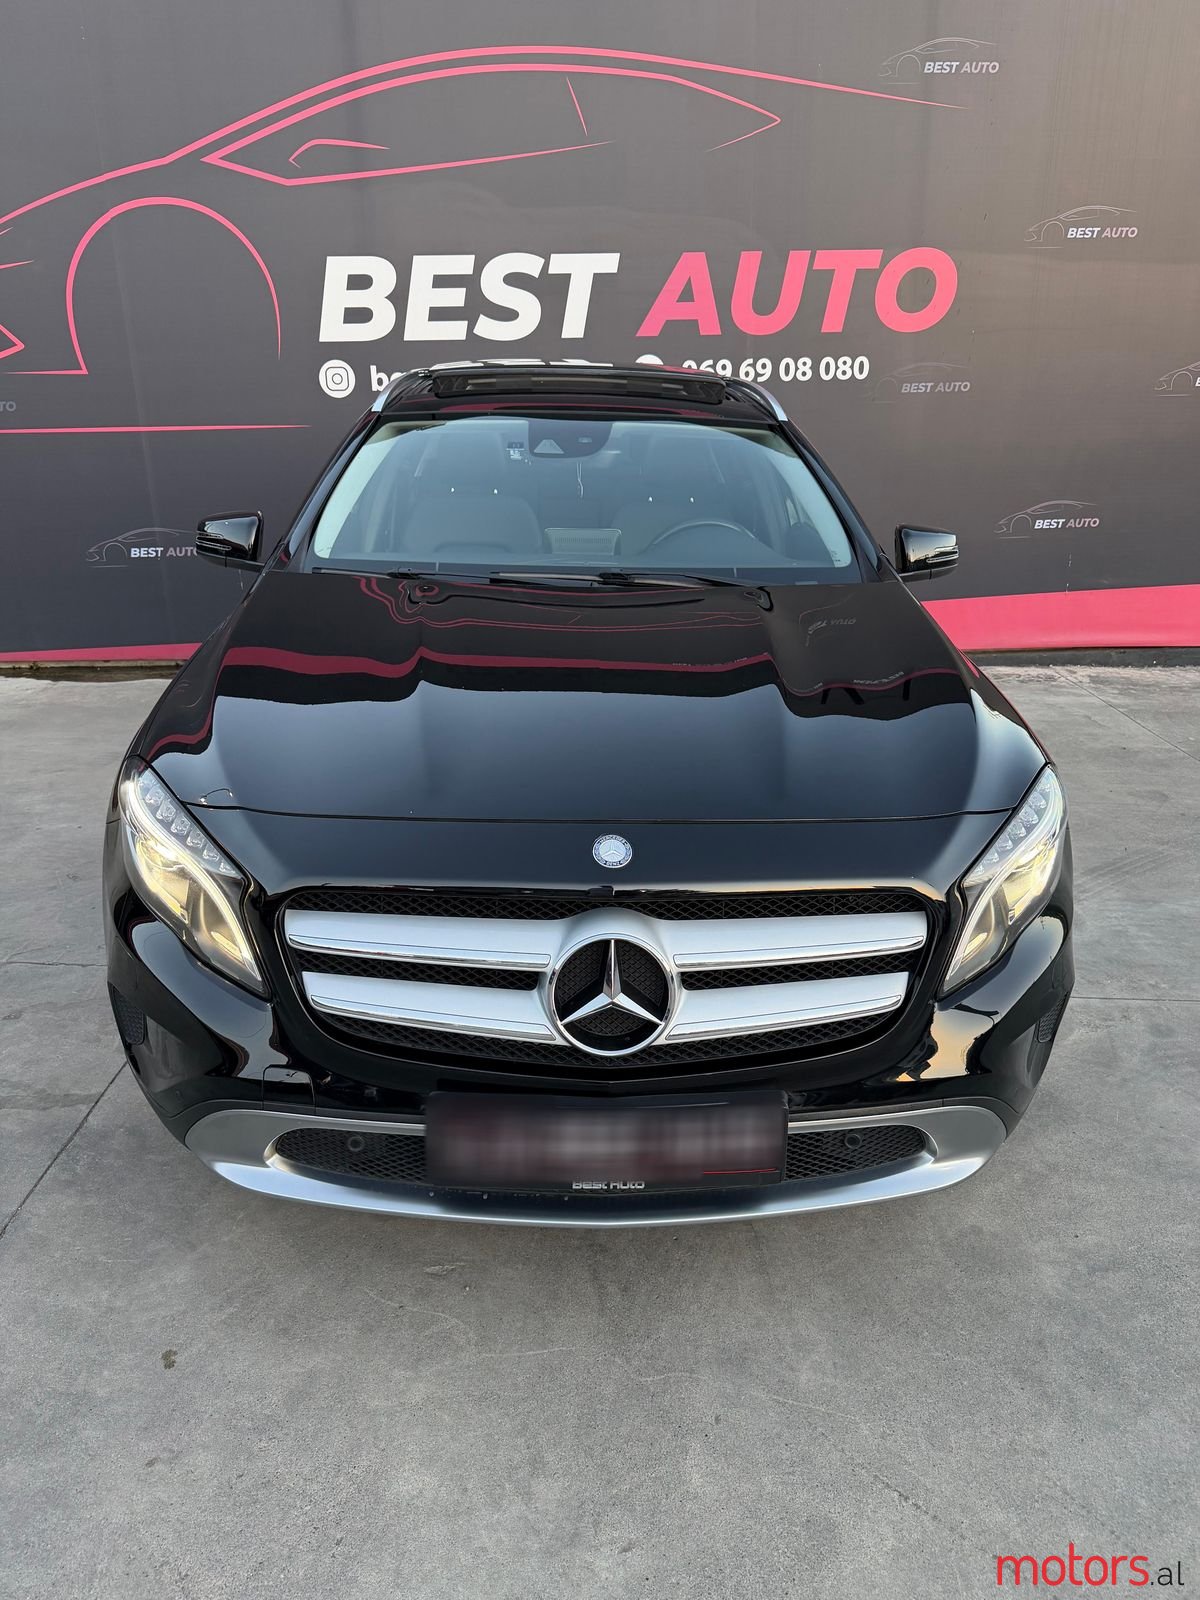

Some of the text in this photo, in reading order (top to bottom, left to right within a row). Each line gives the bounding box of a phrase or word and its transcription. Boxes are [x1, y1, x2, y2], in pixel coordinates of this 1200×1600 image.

[923, 61, 1000, 74] BEST AUTO
[1066, 226, 1138, 239] BEST AUTO
[318, 246, 959, 343] BEST AUTO
[739, 358, 772, 382] 69
[779, 357, 812, 382] 08
[819, 355, 870, 381] 080
[901, 381, 971, 393] BEST AUTO
[1034, 517, 1100, 529] BEST AUTO
[130, 547, 164, 558] BEST
